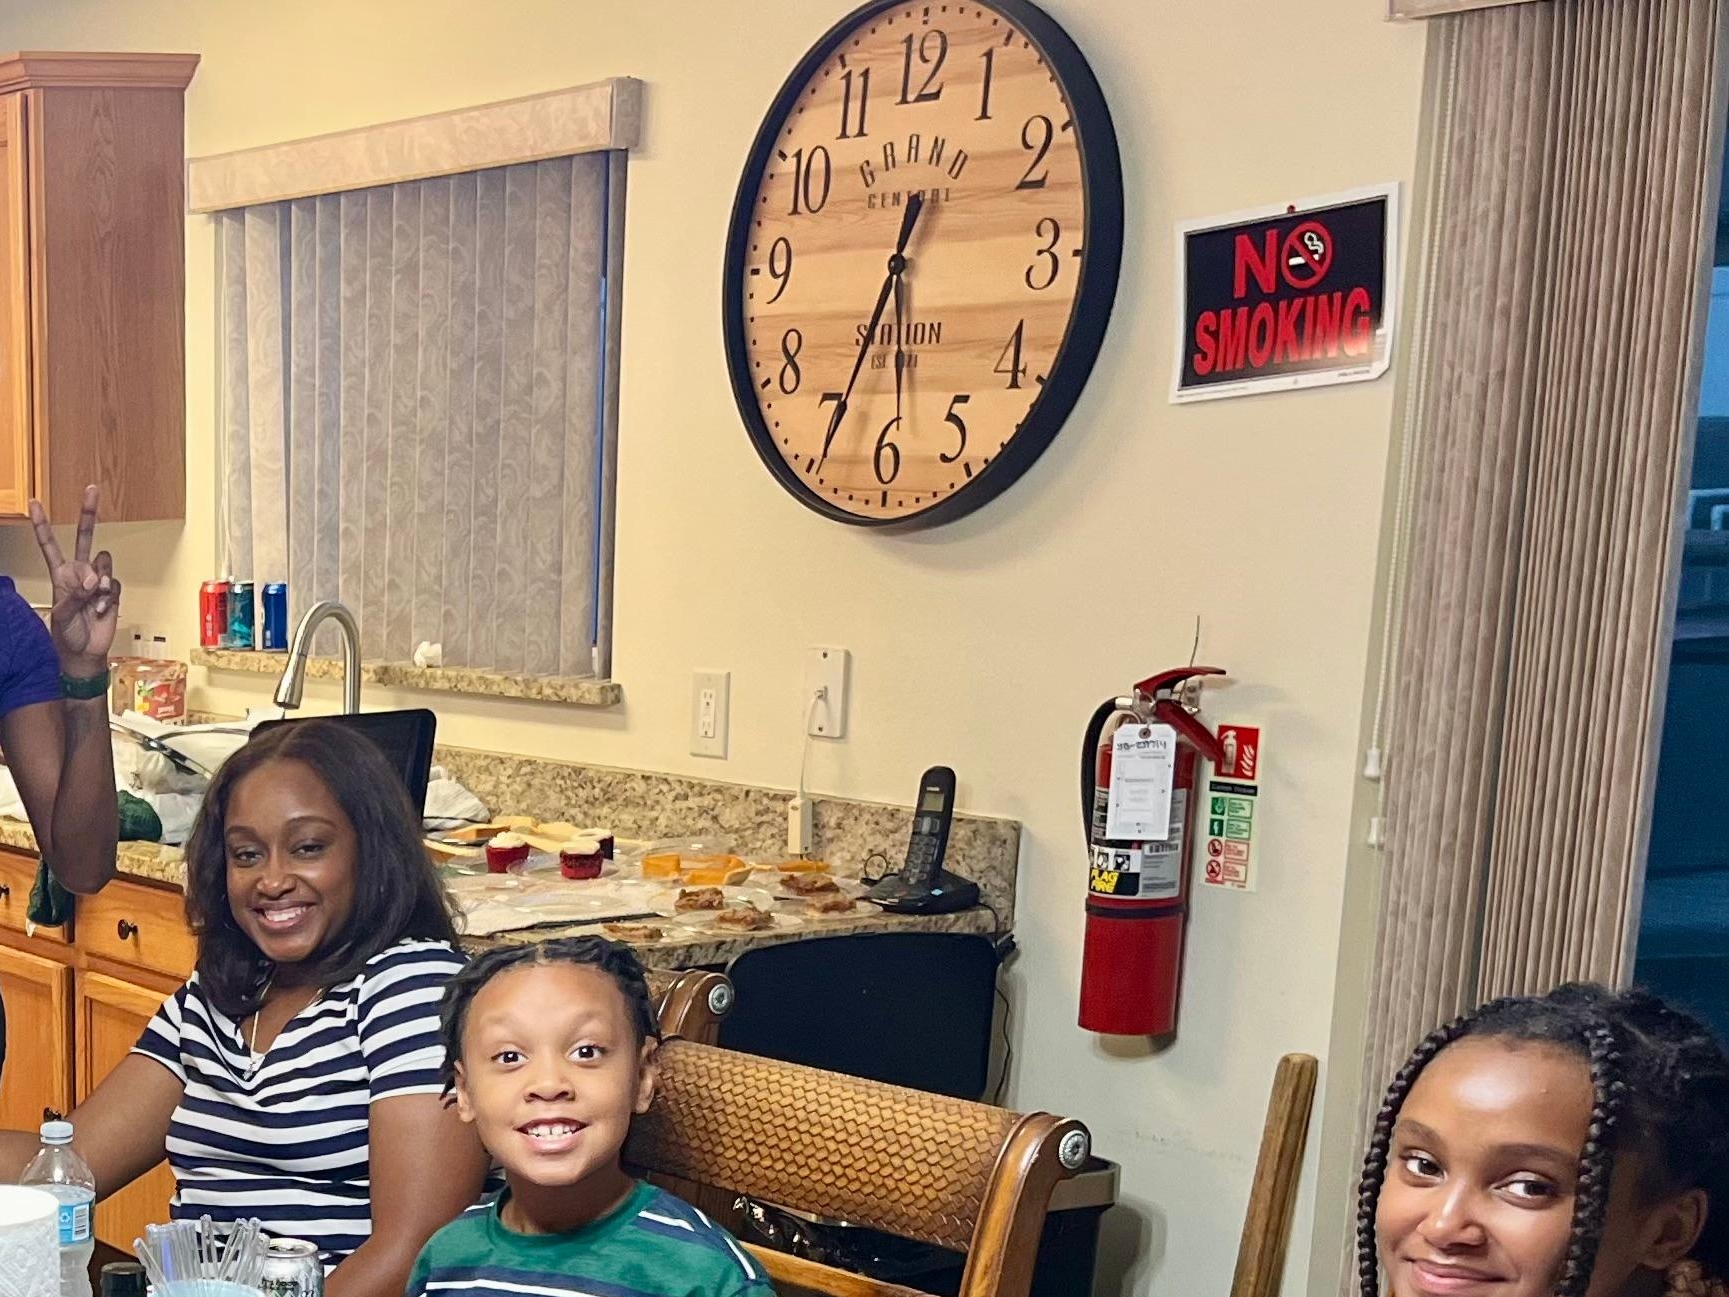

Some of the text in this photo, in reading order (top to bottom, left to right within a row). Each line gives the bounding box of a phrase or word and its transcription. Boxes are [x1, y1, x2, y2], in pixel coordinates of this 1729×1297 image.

[835, 67, 870, 140] 11
[894, 29, 949, 106] 12
[974, 47, 994, 121] 1
[787, 145, 831, 217] 10
[859, 133, 969, 188] GRAND
[1014, 114, 1053, 191] 2
[766, 237, 792, 304] 9
[1025, 217, 1060, 290] 3
[779, 328, 803, 395] 8
[993, 318, 1028, 390] 4
[1192, 287, 1371, 376] SMOKING
[817, 392, 844, 459] 7
[873, 416, 903, 484] 6
[939, 394, 971, 463] 5
